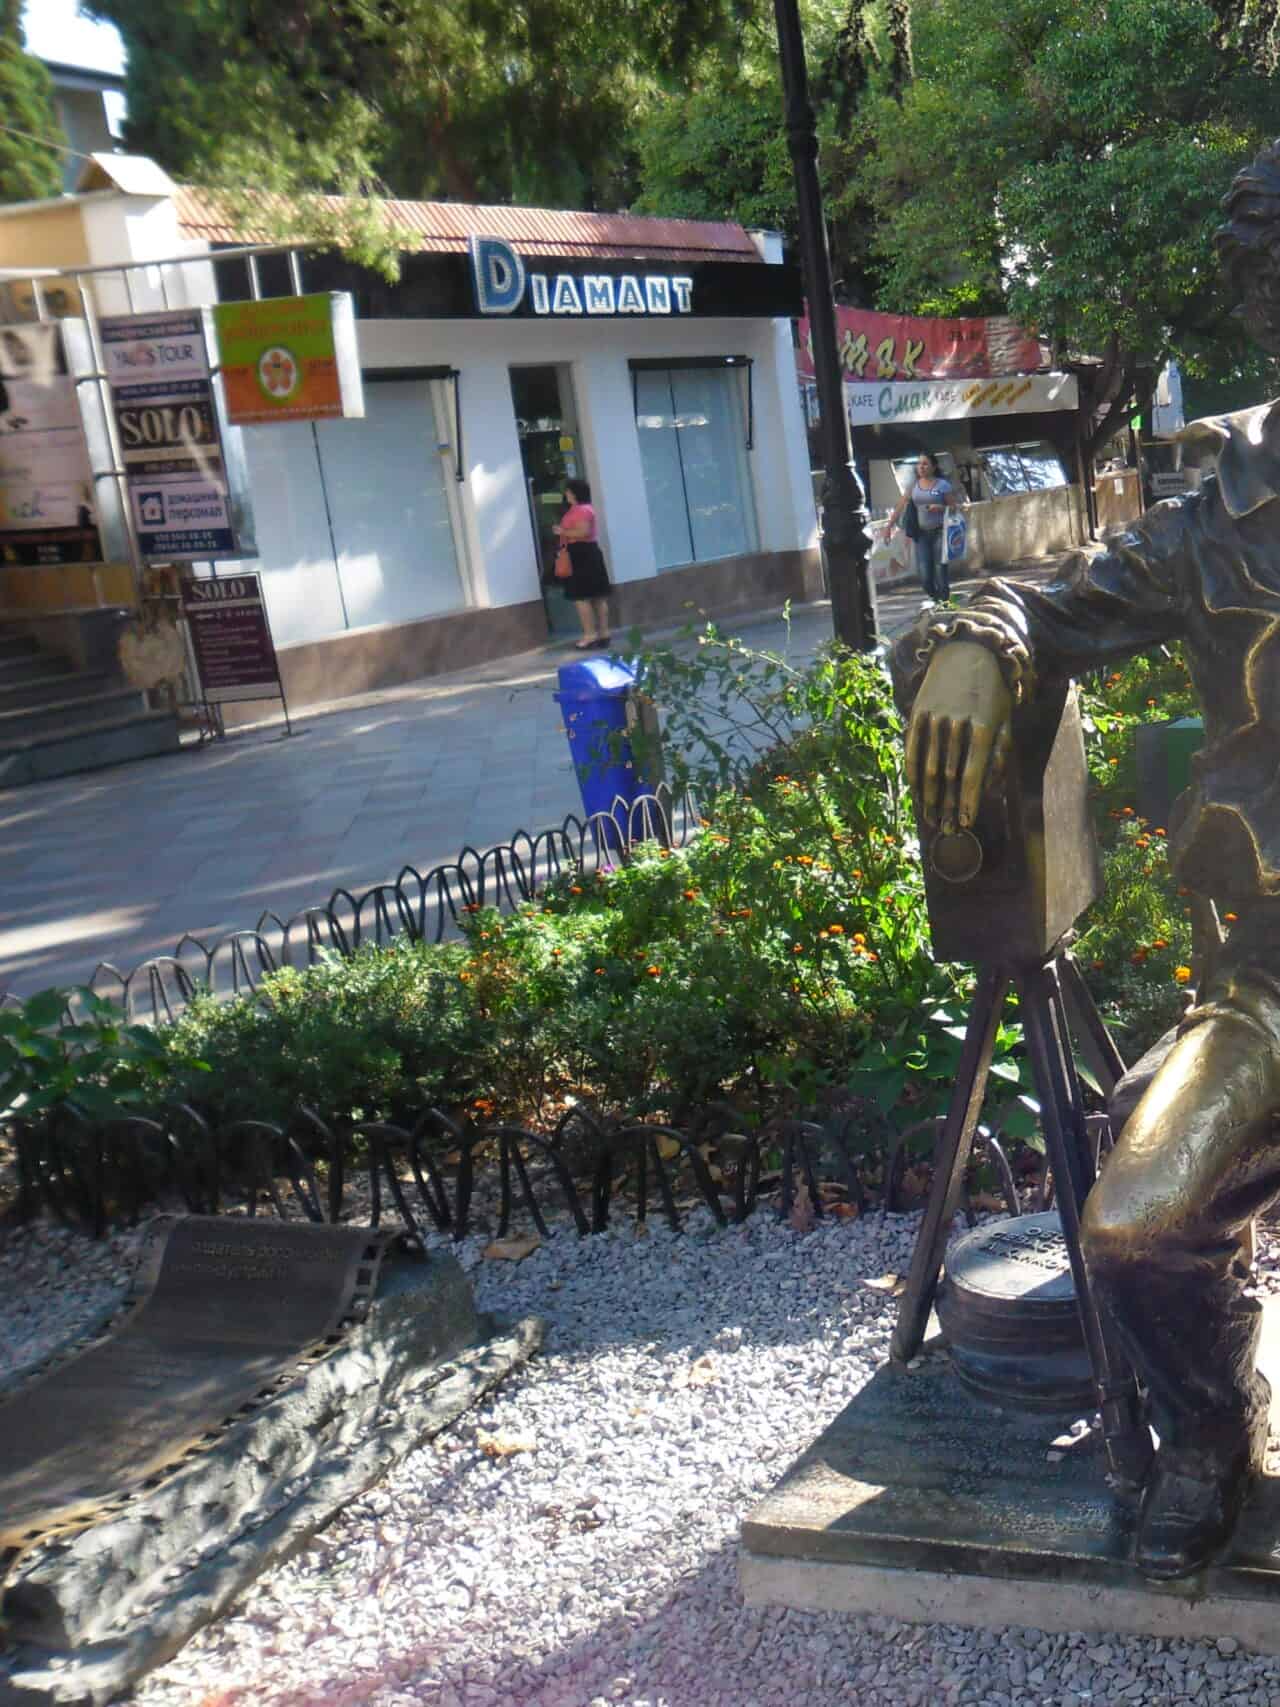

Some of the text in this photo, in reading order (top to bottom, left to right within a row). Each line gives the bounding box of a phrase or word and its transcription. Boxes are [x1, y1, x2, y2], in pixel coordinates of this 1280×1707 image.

[471, 233, 693, 315] DIAMANT
[120, 406, 201, 446] SOLO
[192, 580, 246, 601] SOLO
